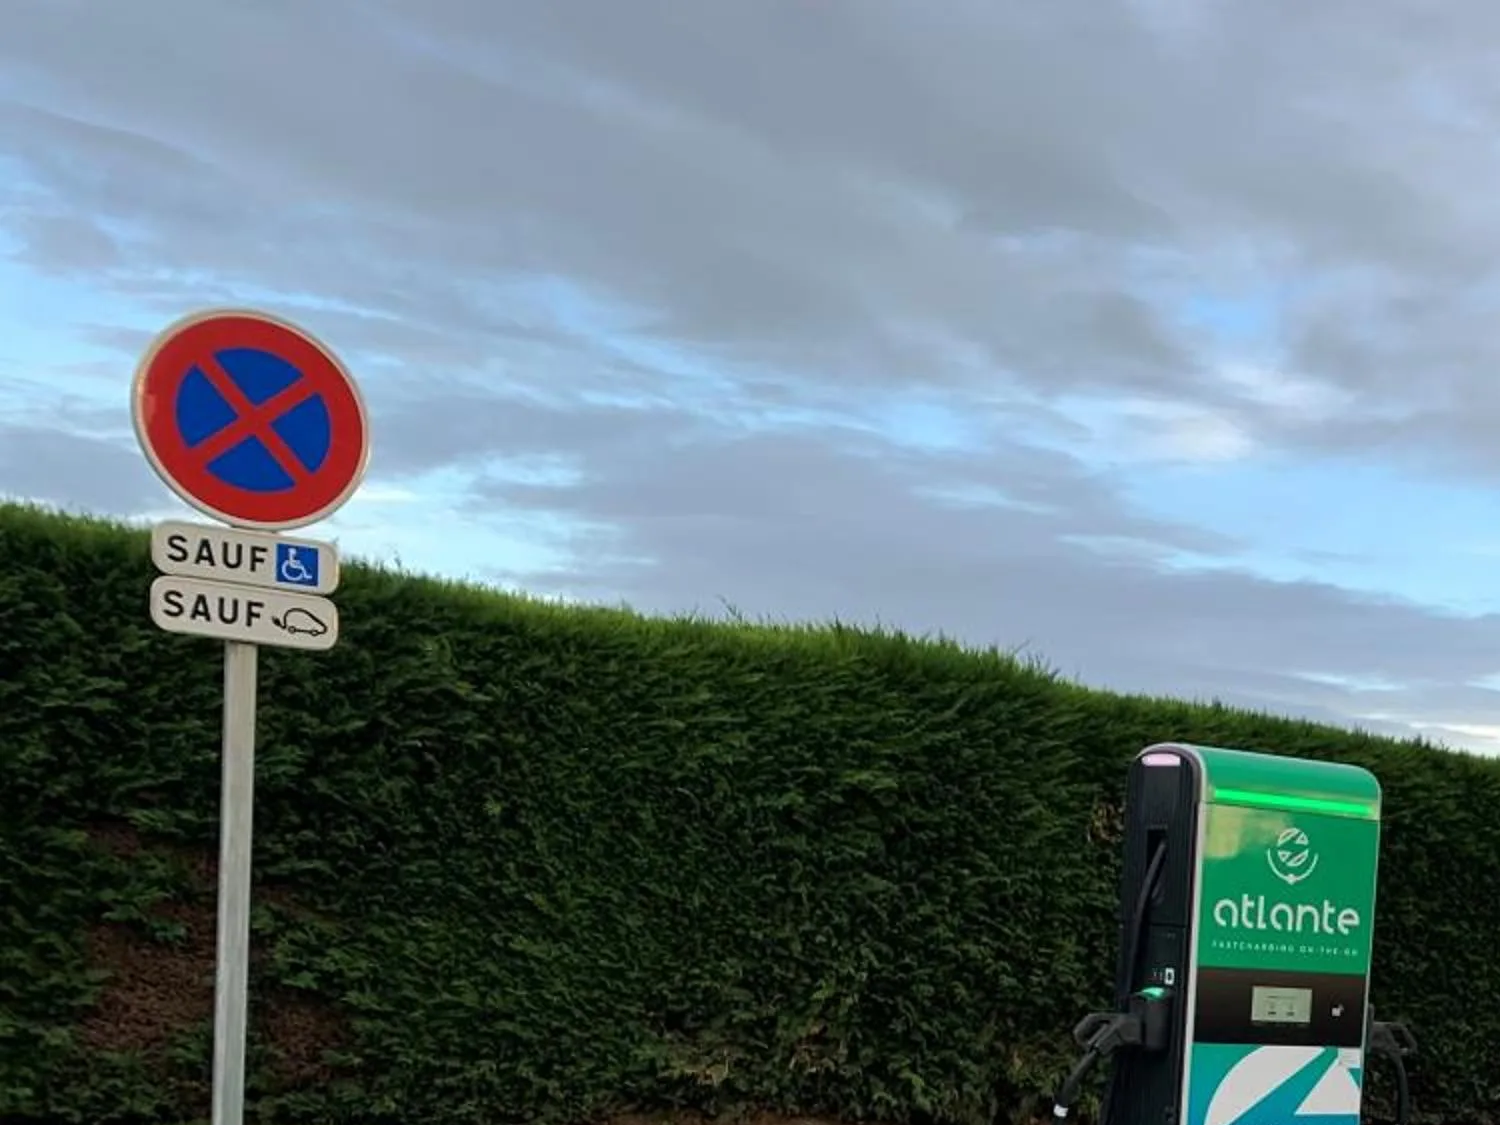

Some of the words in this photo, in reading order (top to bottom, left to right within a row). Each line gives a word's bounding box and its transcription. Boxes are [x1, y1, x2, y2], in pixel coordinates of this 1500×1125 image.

[167, 535, 268, 572] SAUF
[163, 590, 265, 627] SAUF
[1213, 894, 1361, 935] atlante
